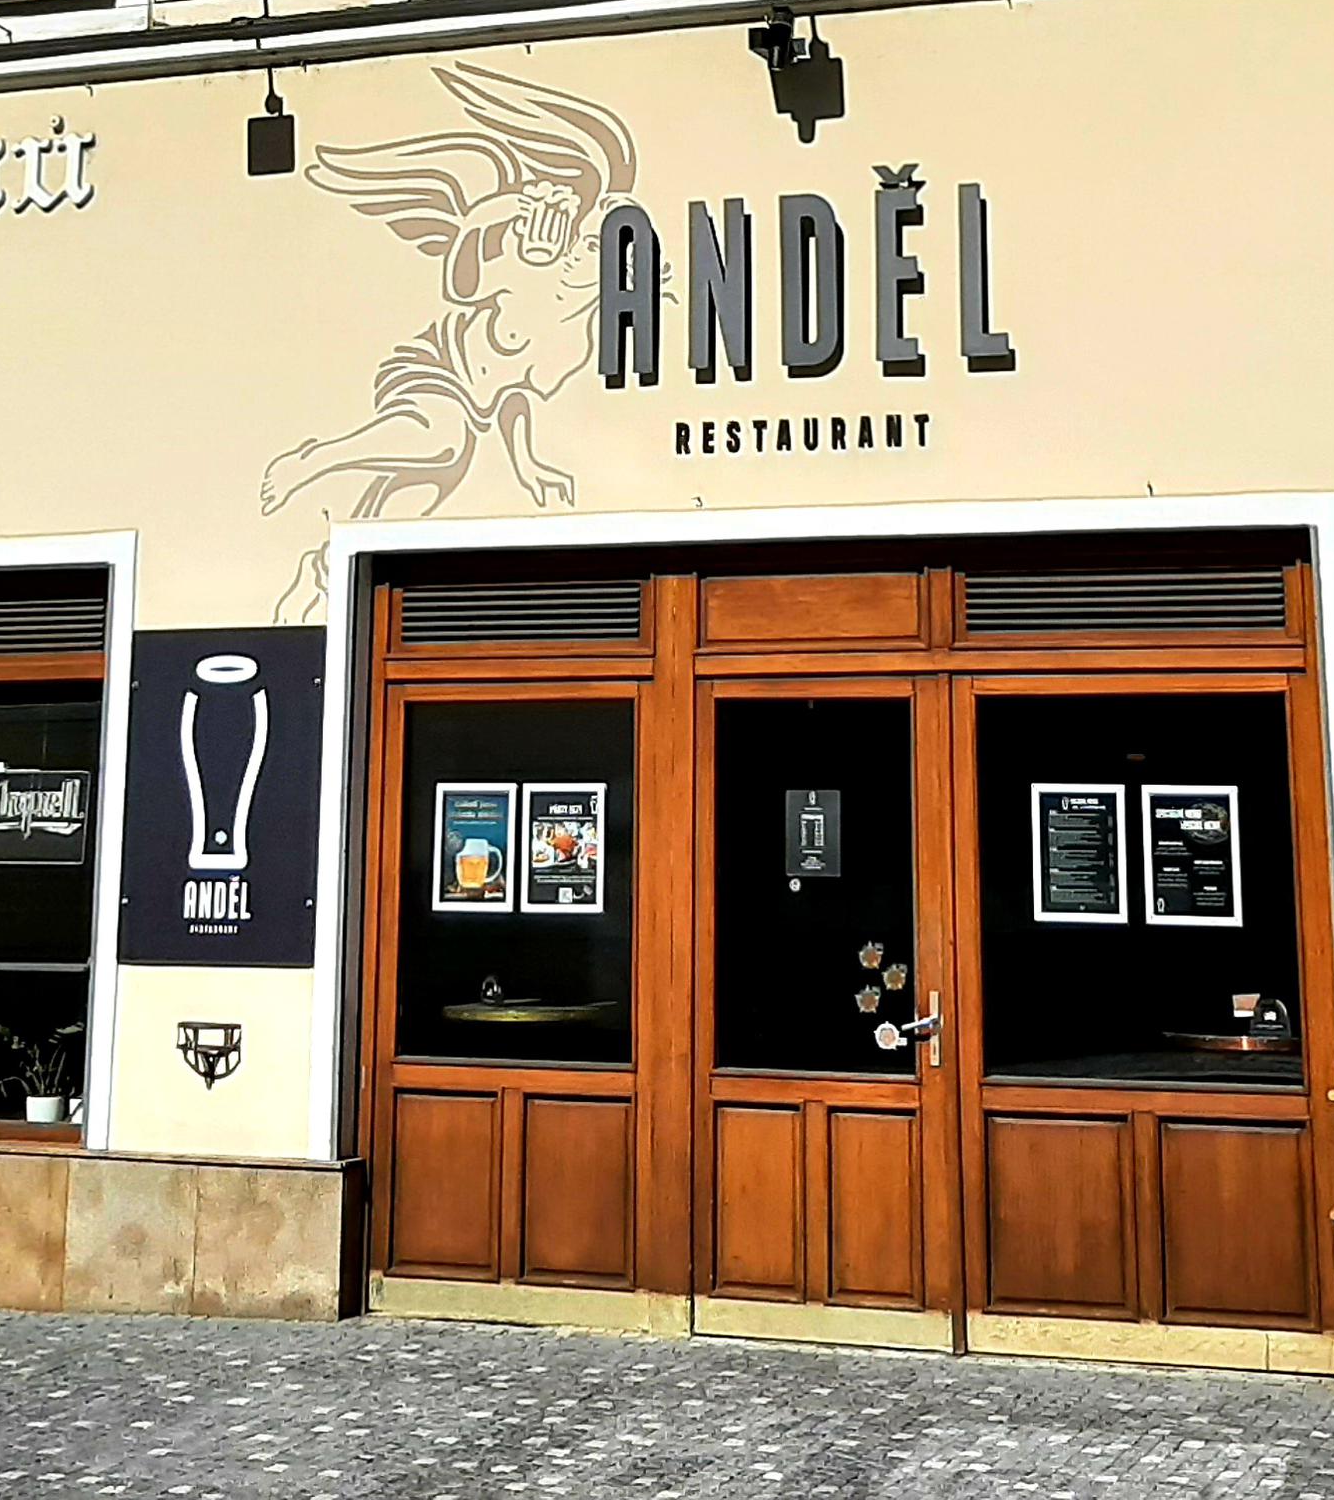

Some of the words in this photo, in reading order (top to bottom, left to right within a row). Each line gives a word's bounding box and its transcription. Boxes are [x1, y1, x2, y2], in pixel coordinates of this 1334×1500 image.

[598, 163, 1015, 389] ANDĚL
[674, 413, 930, 455] RESTAURANT
[183, 874, 252, 920] ANDĚL
